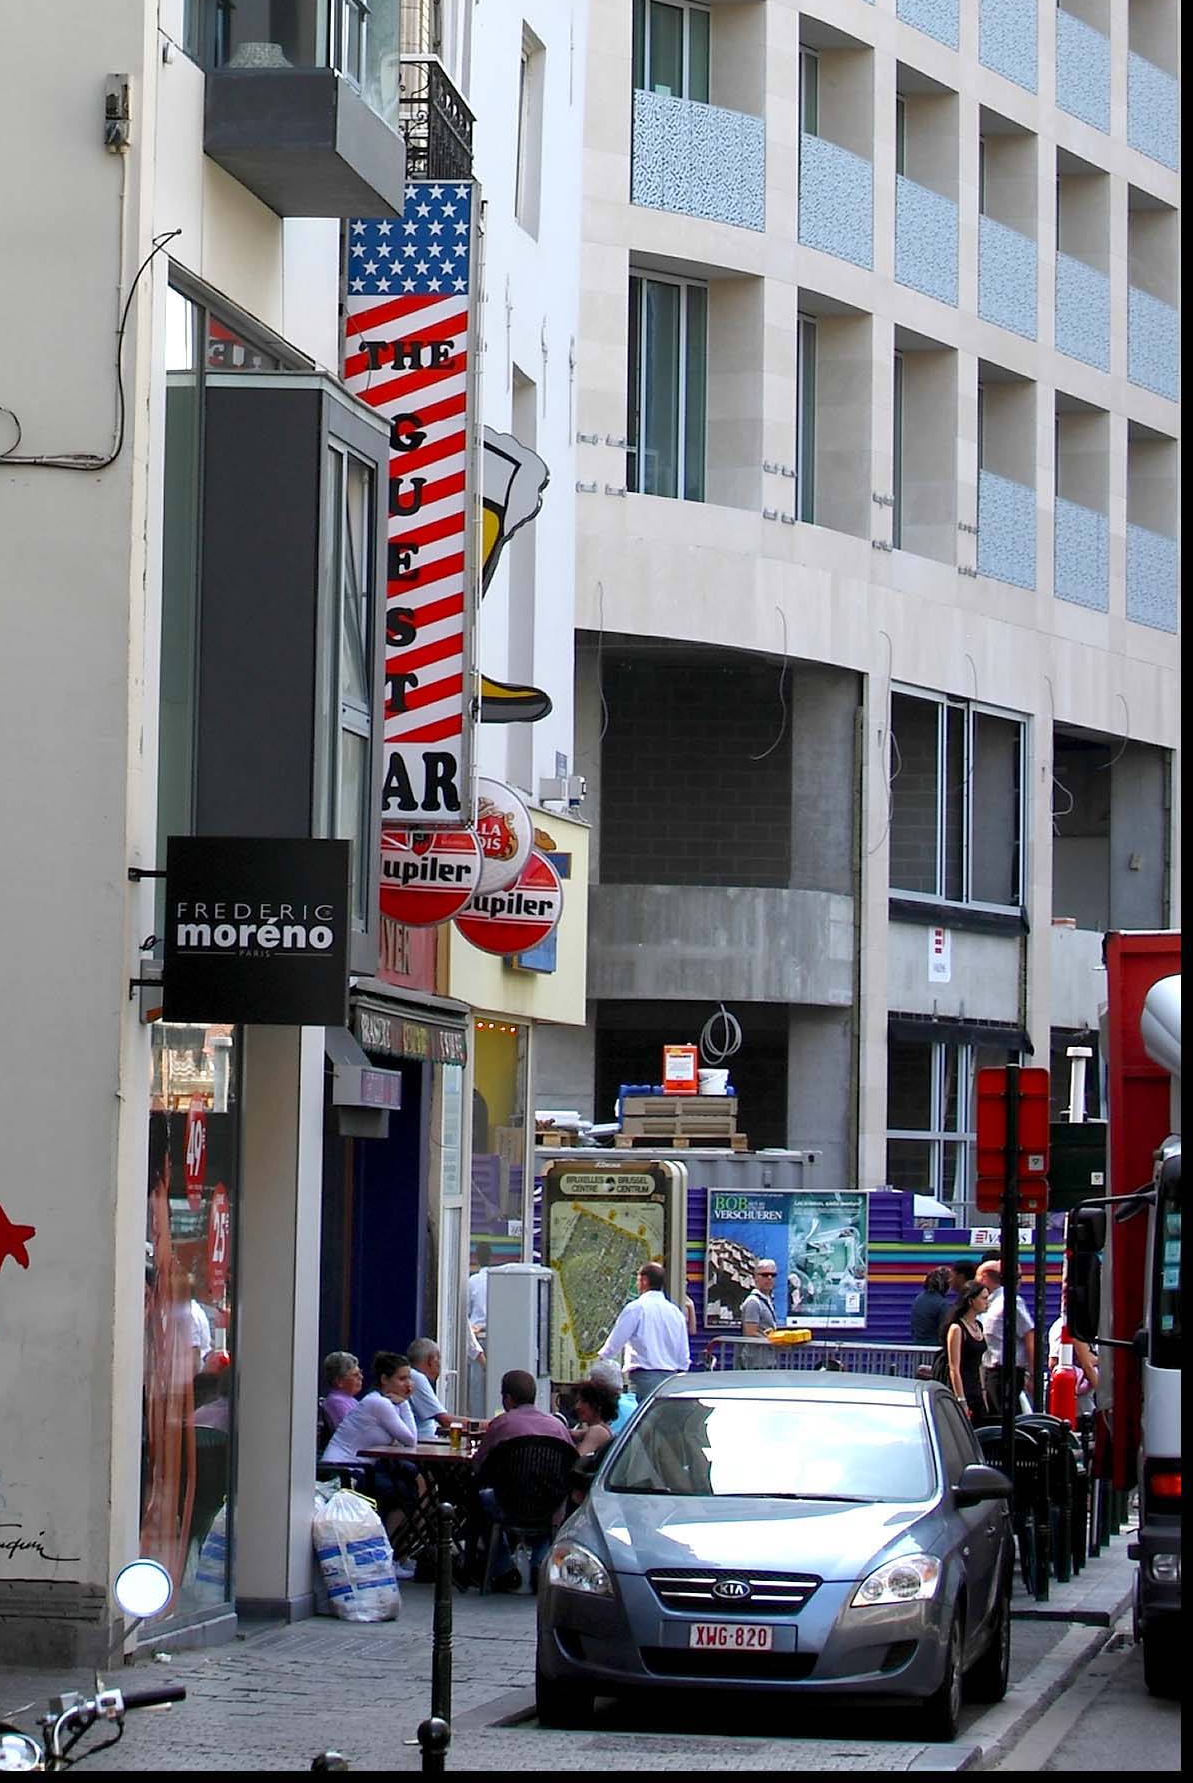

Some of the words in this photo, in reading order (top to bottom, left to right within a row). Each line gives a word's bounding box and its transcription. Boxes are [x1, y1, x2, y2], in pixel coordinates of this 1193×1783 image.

[359, 341, 454, 371] THE
[384, 412, 427, 713] GUEST
[476, 823, 502, 836] LA
[177, 902, 334, 921] FREDERIC
[464, 893, 554, 919] upiler
[177, 917, 334, 949] moréno
[239, 949, 270, 958] PARIS
[566, 1176, 604, 1184] BRUXELLES
[618, 1176, 647, 1184] BRUSSEL
[715, 1197, 748, 1210] BOB
[714, 1210, 782, 1220] VERSCHUEREN
[720, 1584, 744, 1595] KIA
